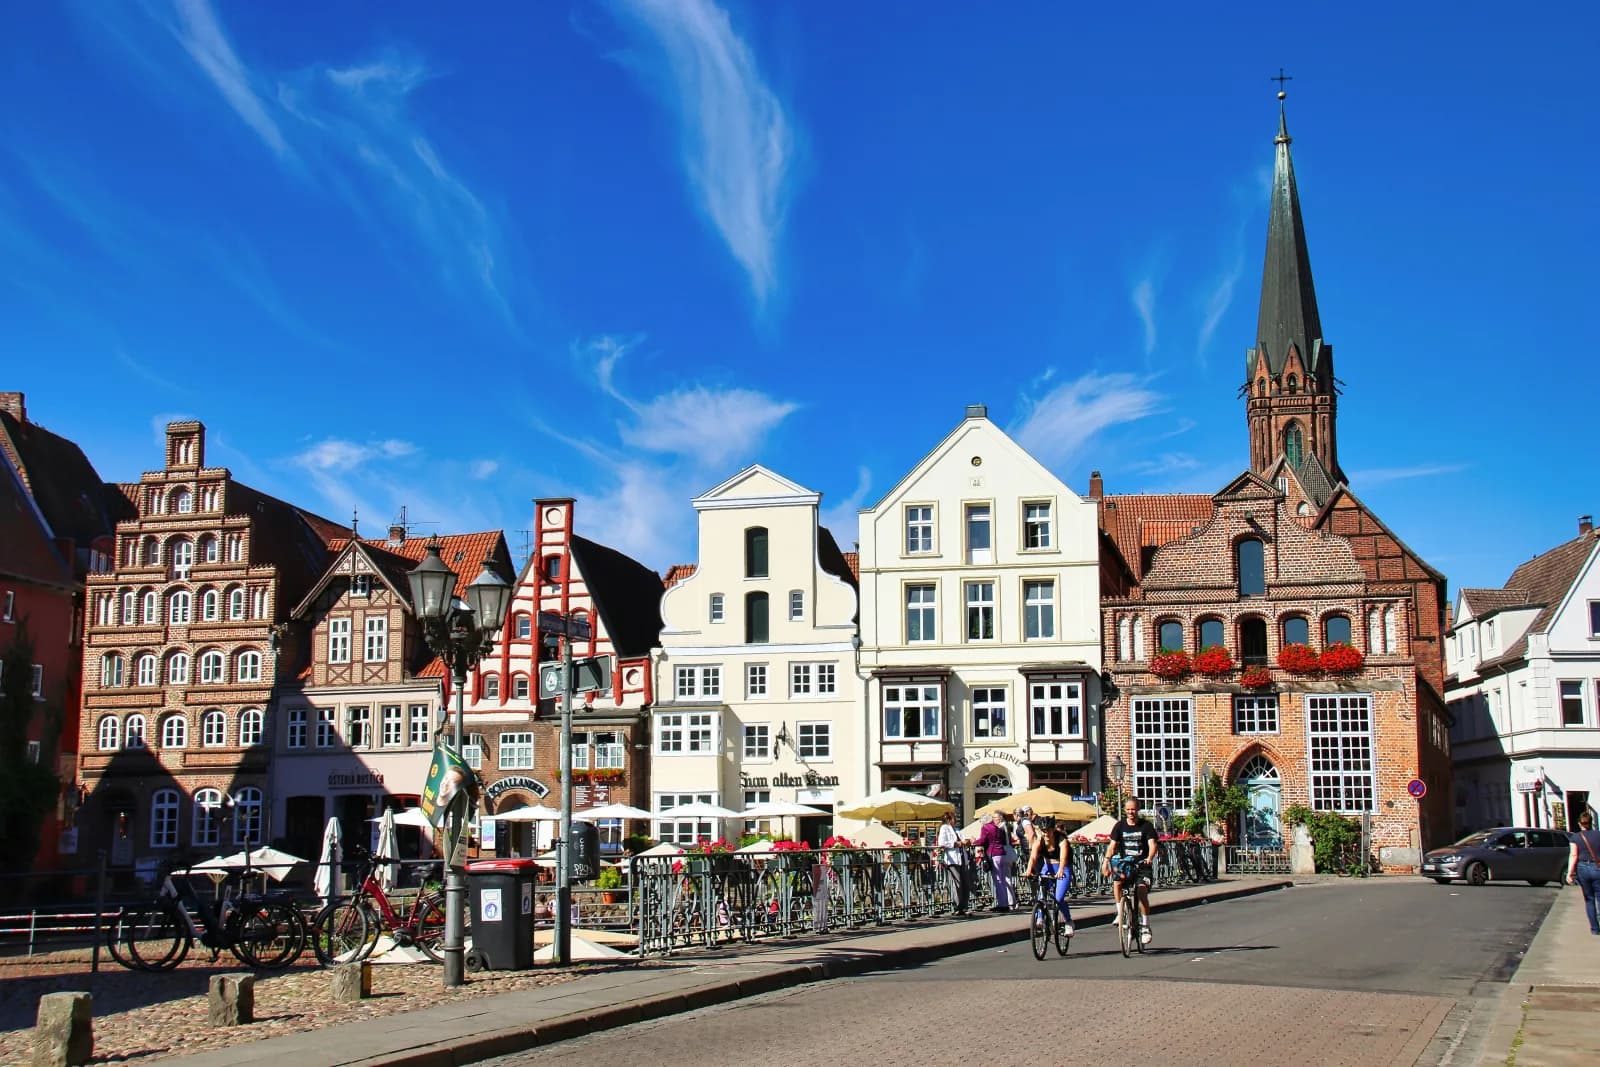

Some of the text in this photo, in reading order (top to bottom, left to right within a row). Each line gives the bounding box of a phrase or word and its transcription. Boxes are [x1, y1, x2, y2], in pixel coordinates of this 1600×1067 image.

[958, 752, 981, 768] DAS
[328, 774, 384, 785] OSTERIA RUSTICA
[488, 777, 545, 796] SCHALLANDER
[739, 771, 839, 788] Zum alten Kran
